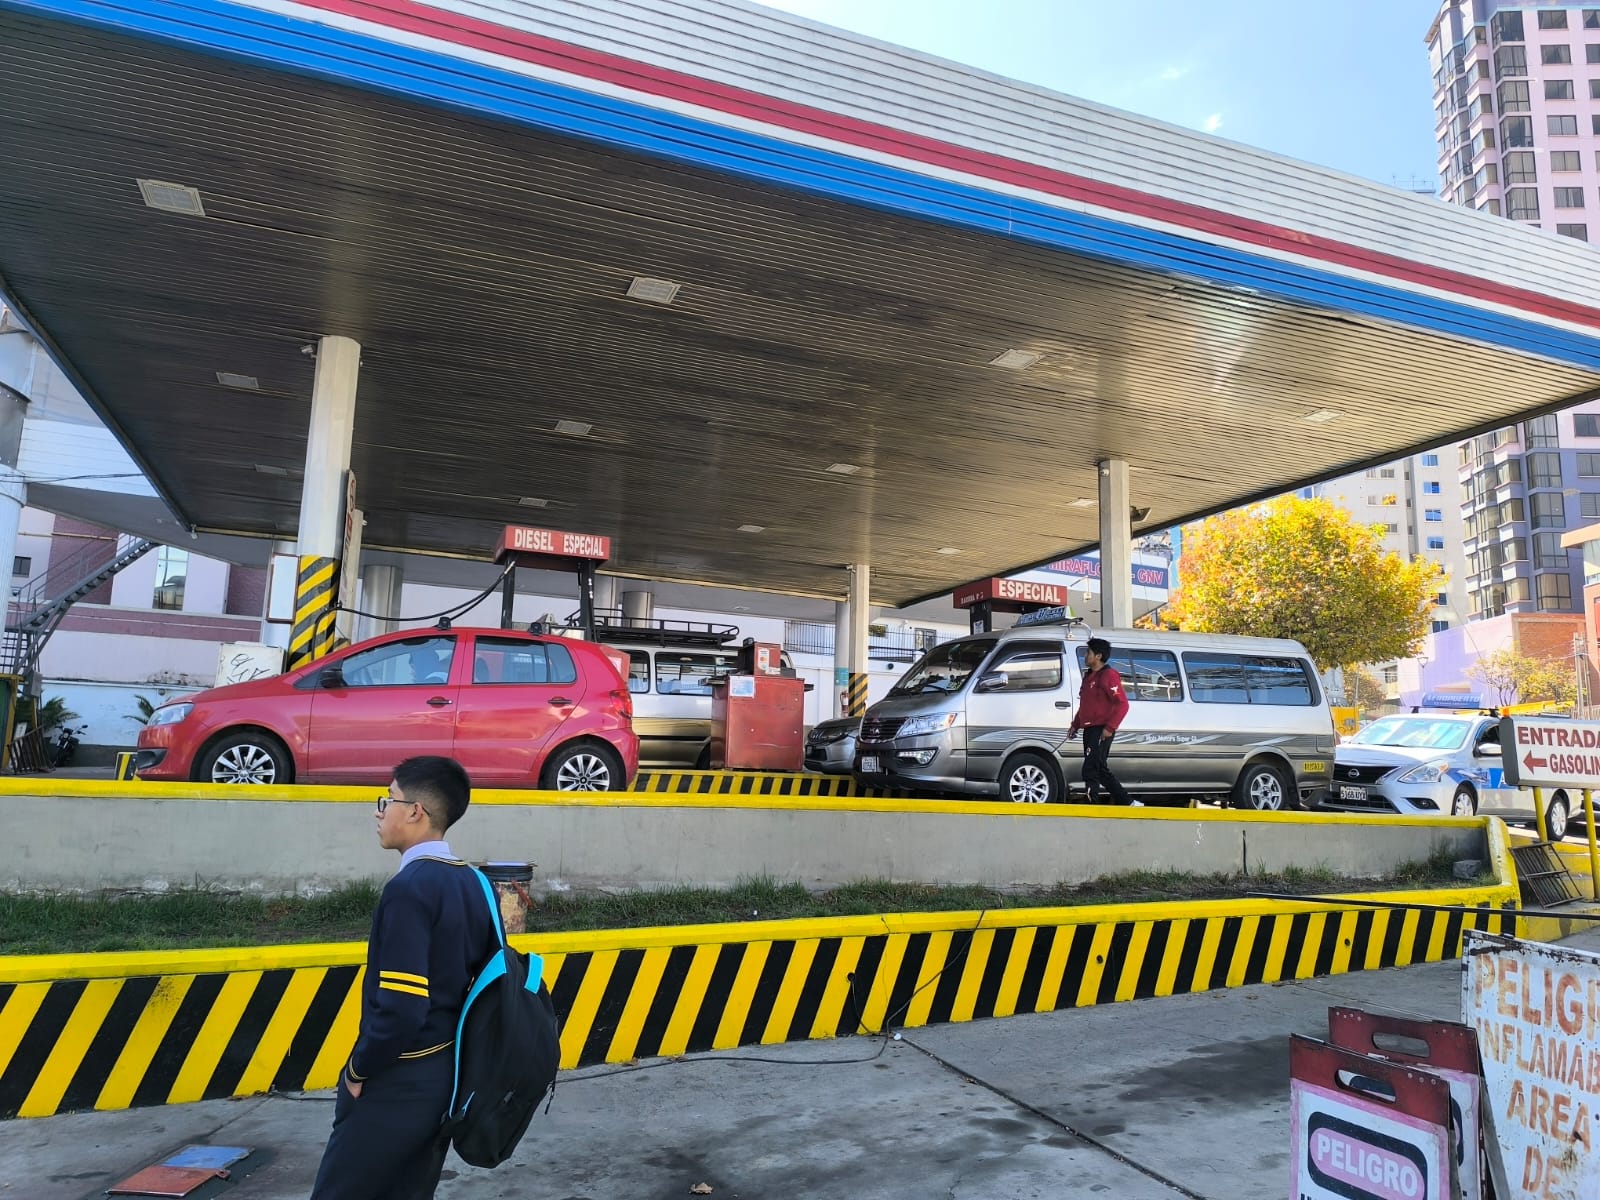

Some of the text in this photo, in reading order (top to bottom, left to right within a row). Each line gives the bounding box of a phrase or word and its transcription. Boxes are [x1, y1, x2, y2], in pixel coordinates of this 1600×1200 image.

[514, 528, 604, 556] DIESEL ESPECIAL
[998, 580, 1061, 603] ESPECIAL
[1138, 568, 1163, 585] GNV
[1507, 1079, 1591, 1152] AREA
[1317, 1133, 1418, 1197] PELIGRO
[1522, 1145, 1563, 1200] DE
